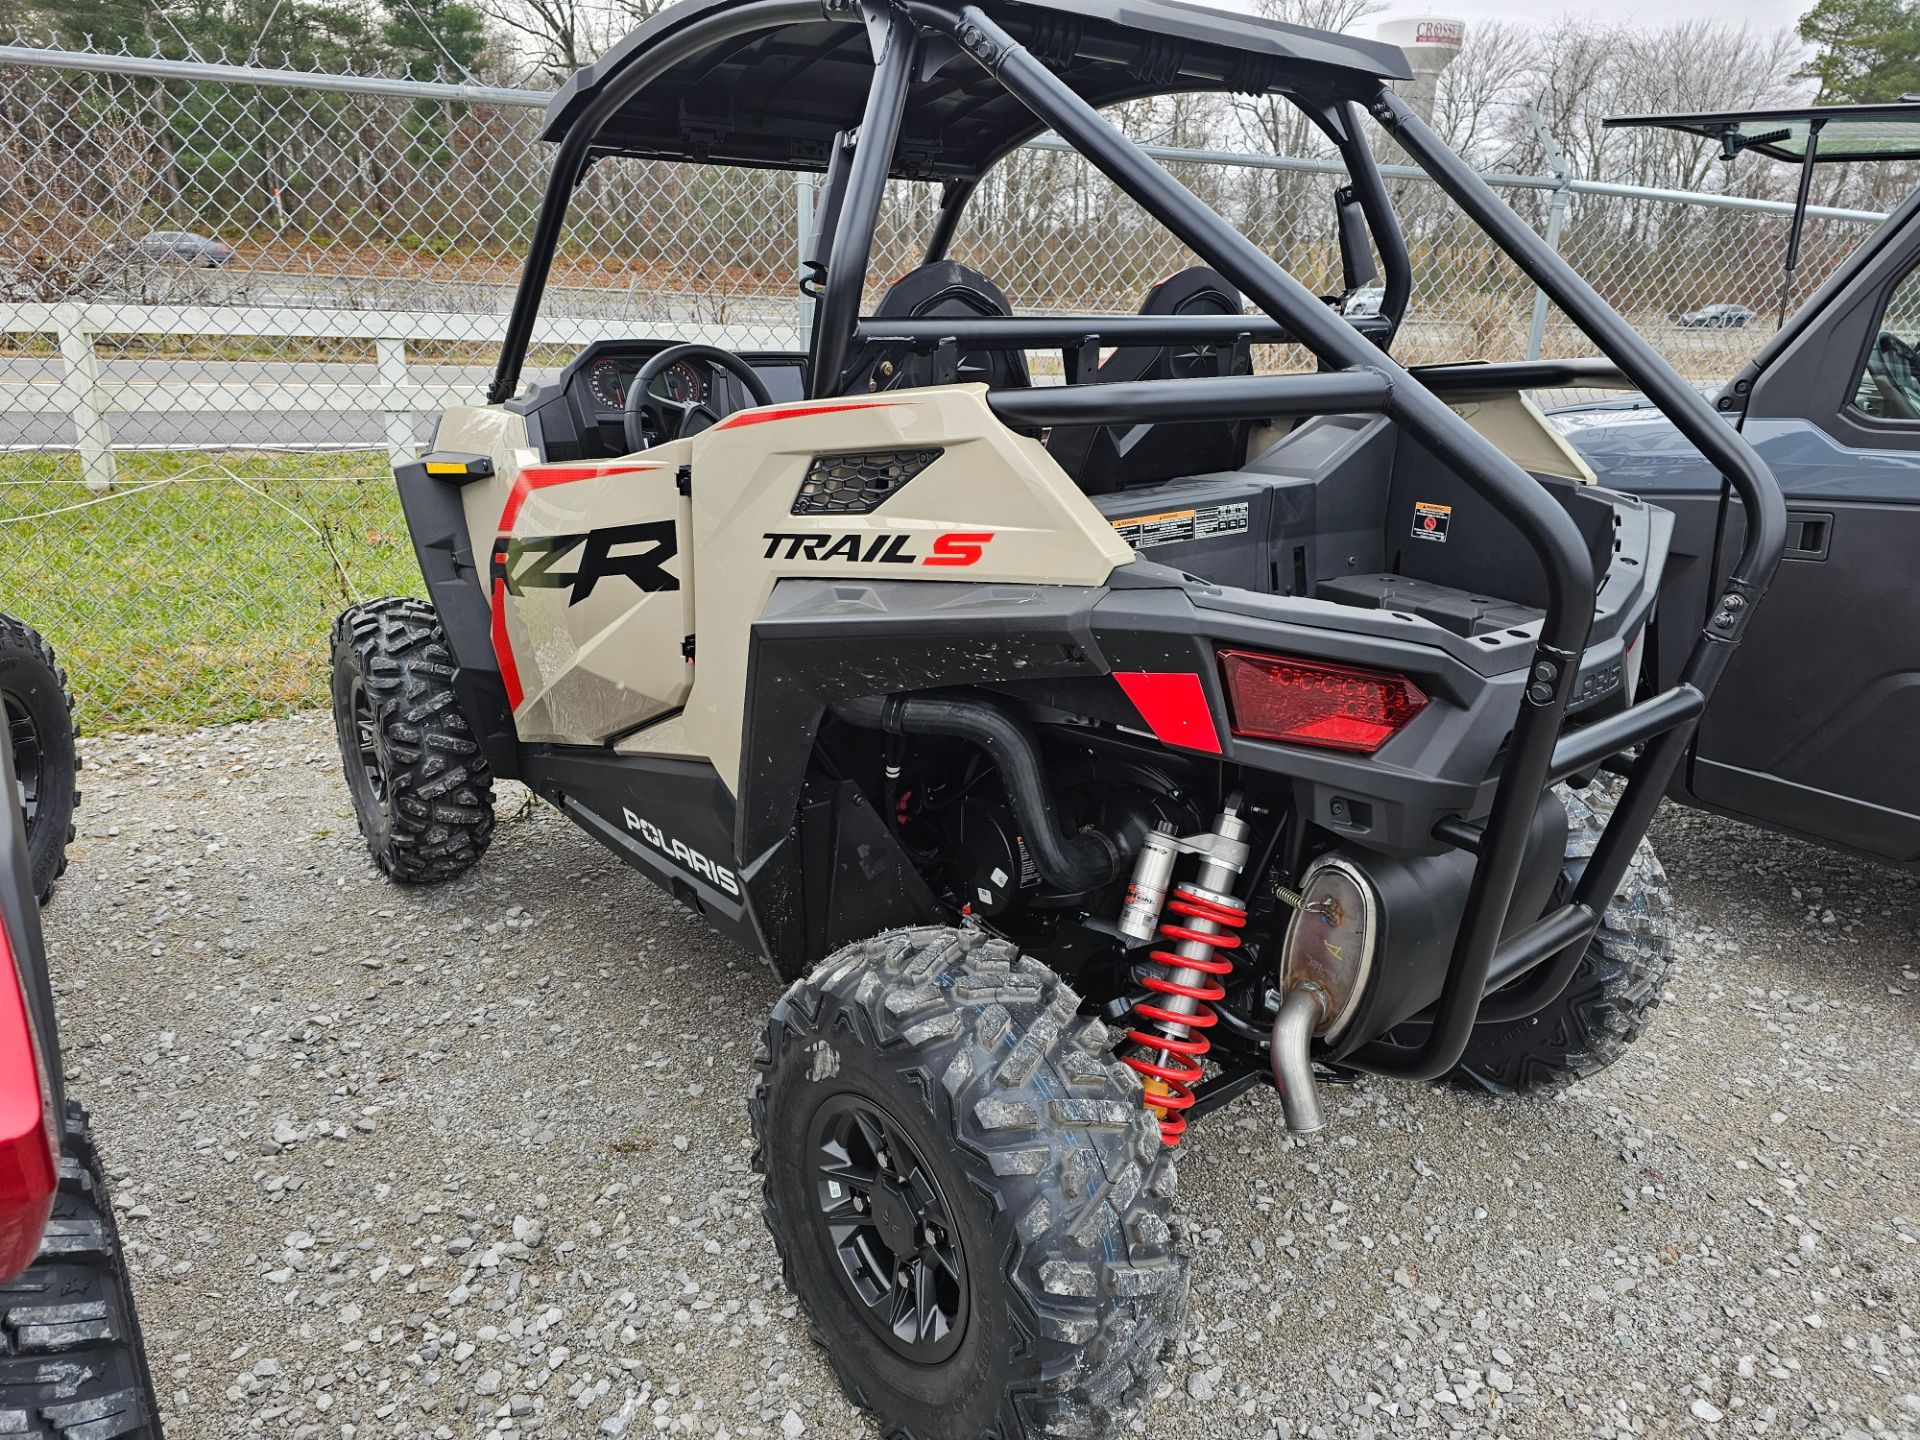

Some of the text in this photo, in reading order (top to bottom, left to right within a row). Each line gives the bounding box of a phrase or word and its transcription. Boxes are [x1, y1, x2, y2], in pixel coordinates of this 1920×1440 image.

[762, 532, 996, 566] TRAIL S
[622, 806, 740, 896] POLARIS
